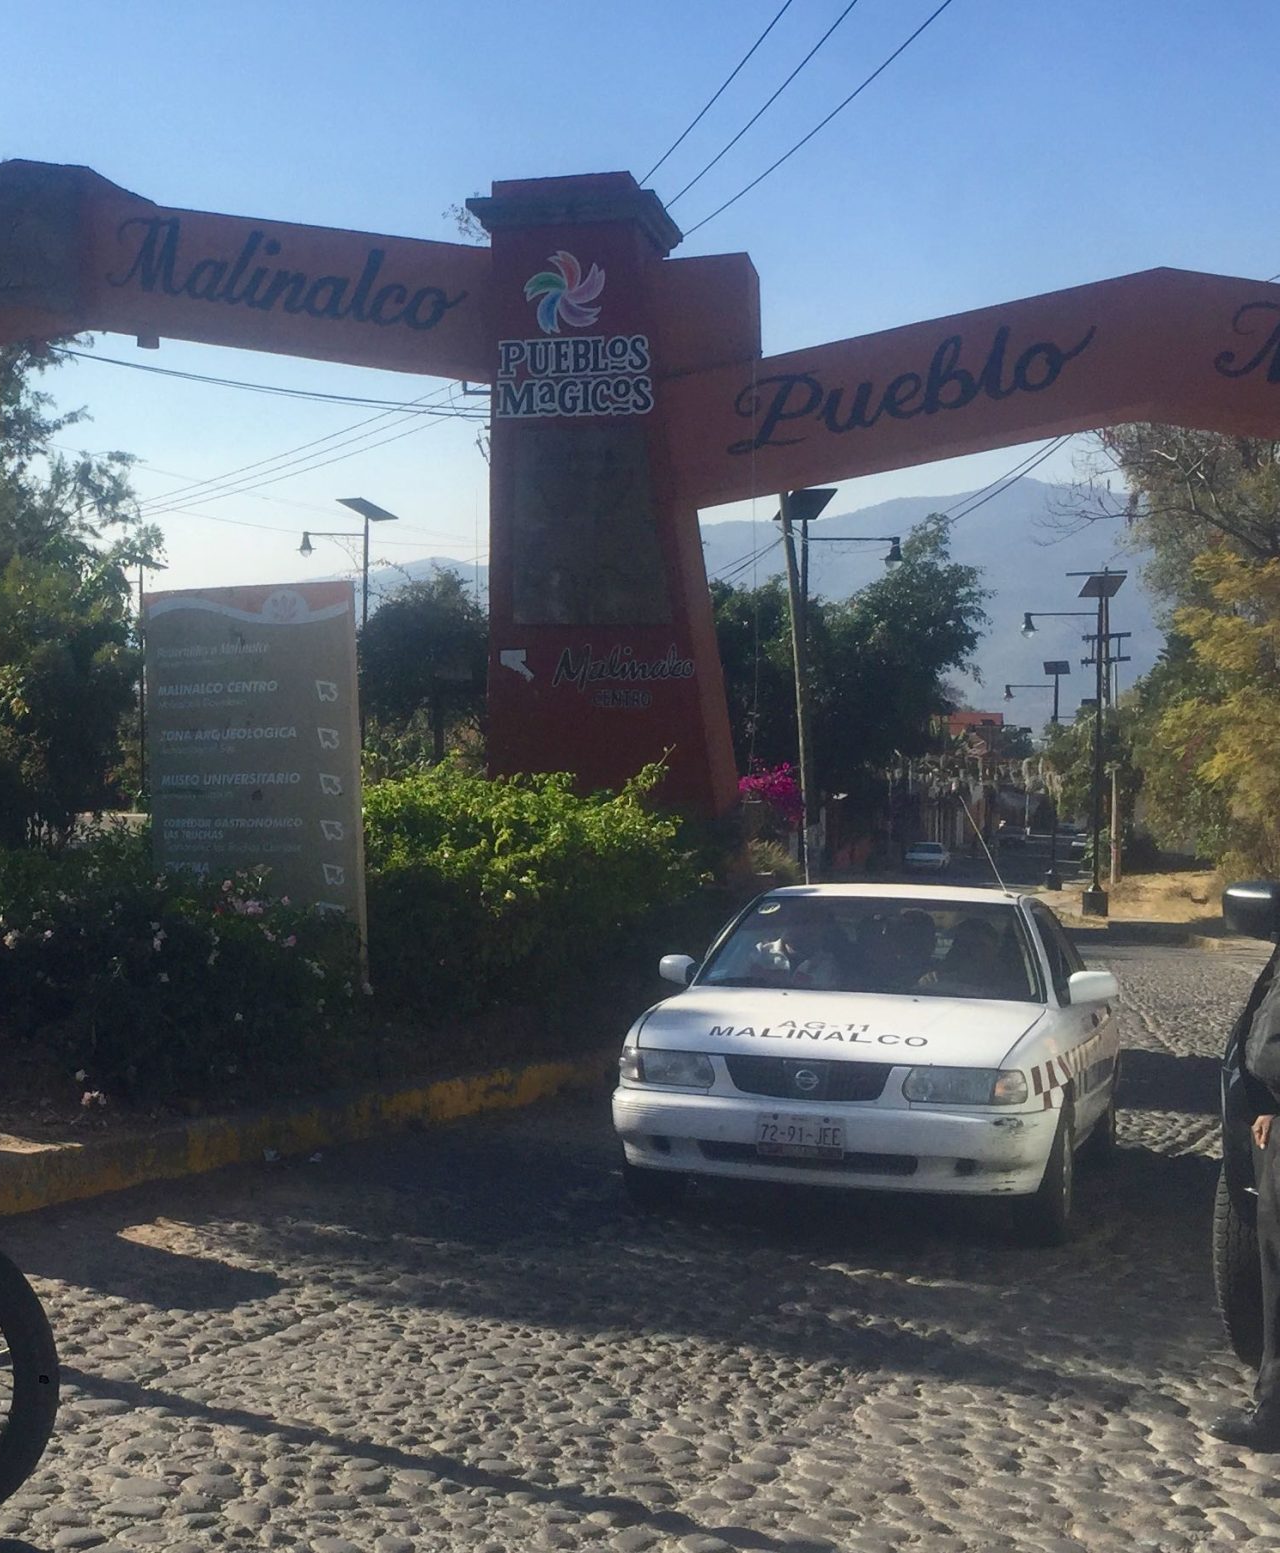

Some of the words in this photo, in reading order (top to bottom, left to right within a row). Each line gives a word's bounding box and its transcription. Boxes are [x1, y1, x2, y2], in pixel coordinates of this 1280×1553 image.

[106, 215, 466, 331] Malinalco
[727, 324, 1097, 456] Pueblo
[551, 644, 694, 694] Malinalco
[158, 682, 223, 696] MALINALCO
[227, 680, 278, 693] CENTRO
[592, 688, 653, 708] CENTRO
[161, 774, 200, 786] MUSEO
[203, 772, 301, 785] UNIVERSITARIO
[708, 1025, 928, 1048] MALINALCO
[776, 1019, 870, 1033] AG-11
